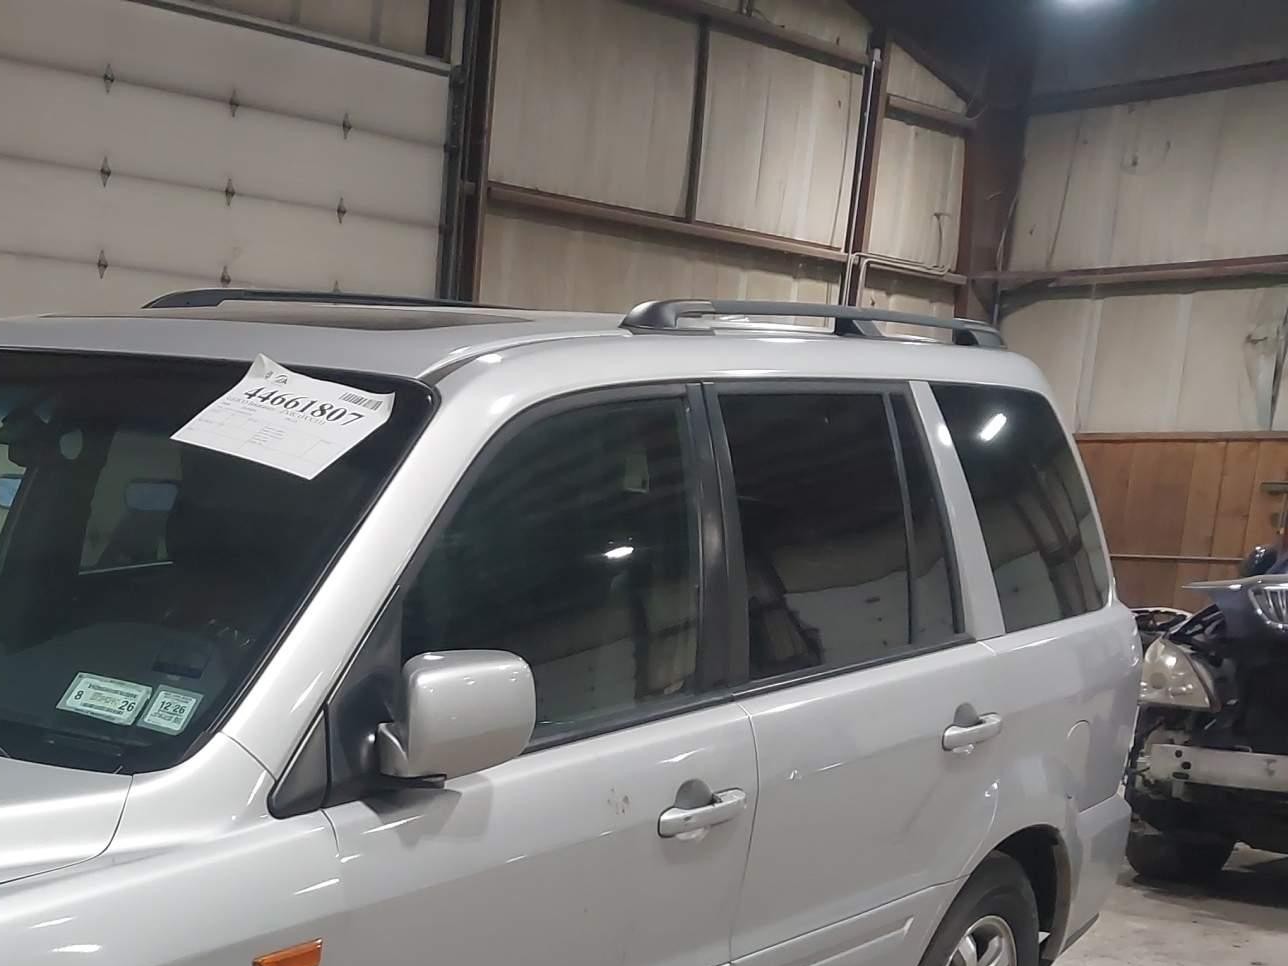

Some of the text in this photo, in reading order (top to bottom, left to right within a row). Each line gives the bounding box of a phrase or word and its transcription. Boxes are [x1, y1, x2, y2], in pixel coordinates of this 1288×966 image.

[243, 385, 364, 426] 44661807
[74, 690, 84, 701] 8
[117, 700, 136, 712] 26
